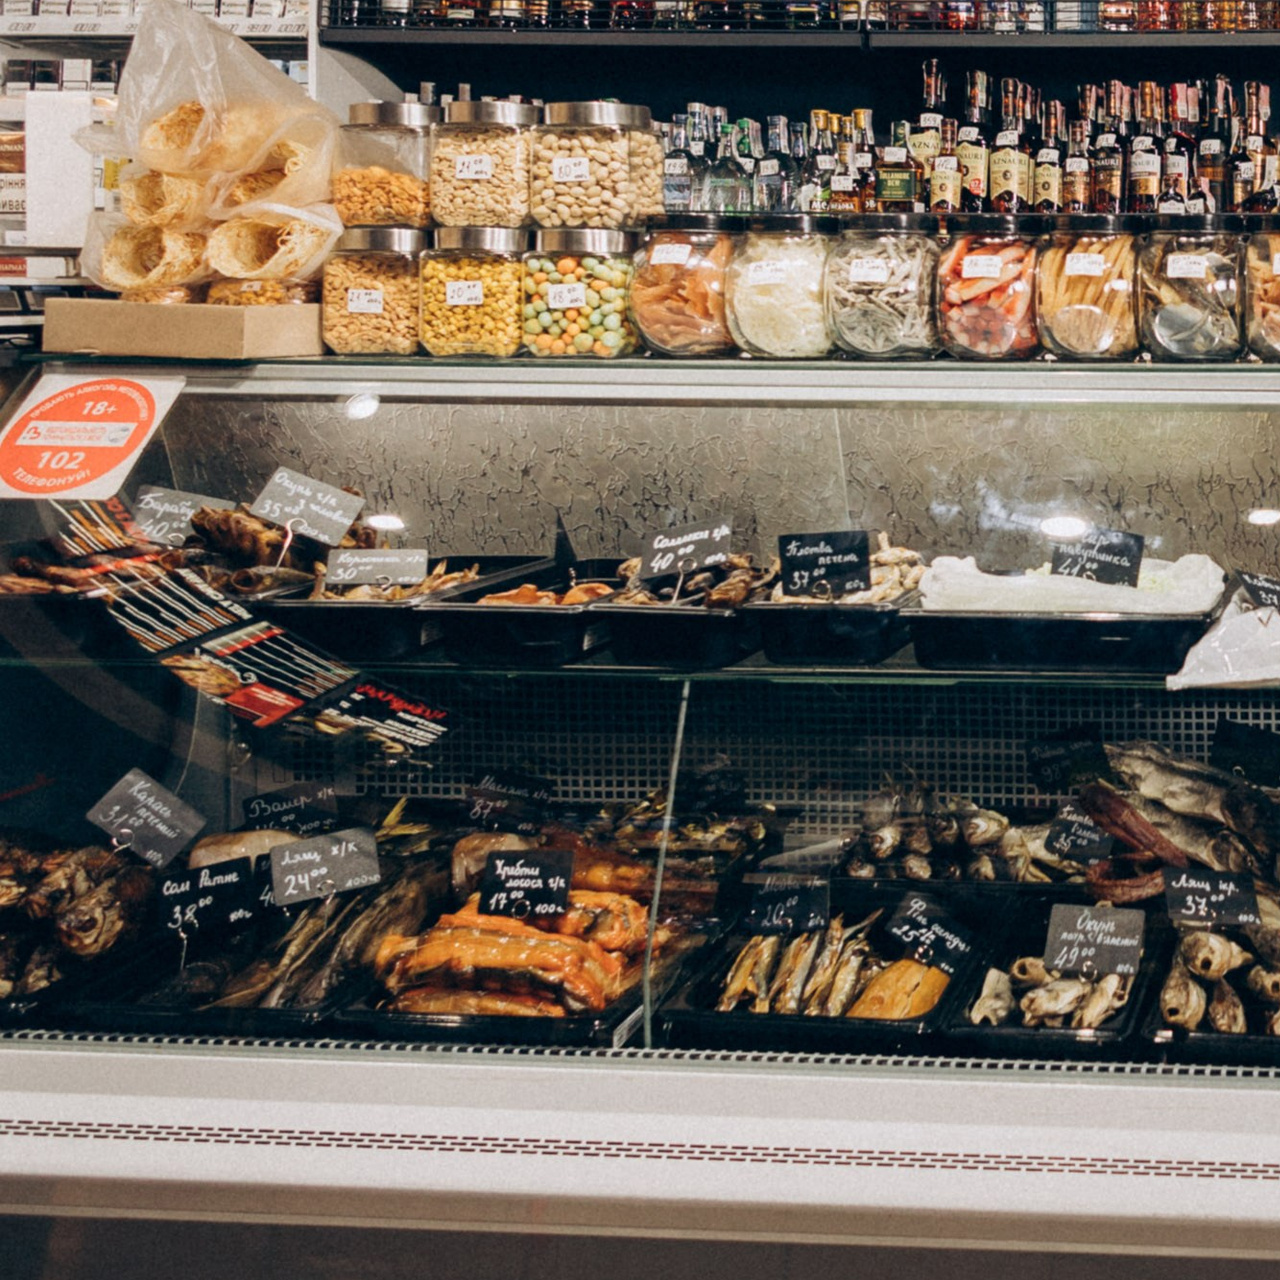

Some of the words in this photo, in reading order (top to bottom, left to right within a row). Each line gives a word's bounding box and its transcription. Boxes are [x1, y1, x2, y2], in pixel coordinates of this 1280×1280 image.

[81, 400, 119, 417] 18+
[38, 451, 86, 470] 102
[331, 840, 358, 859] х/к
[285, 871, 309, 896] 24
[489, 891, 507, 911] 17
[1053, 945, 1079, 968] 49
